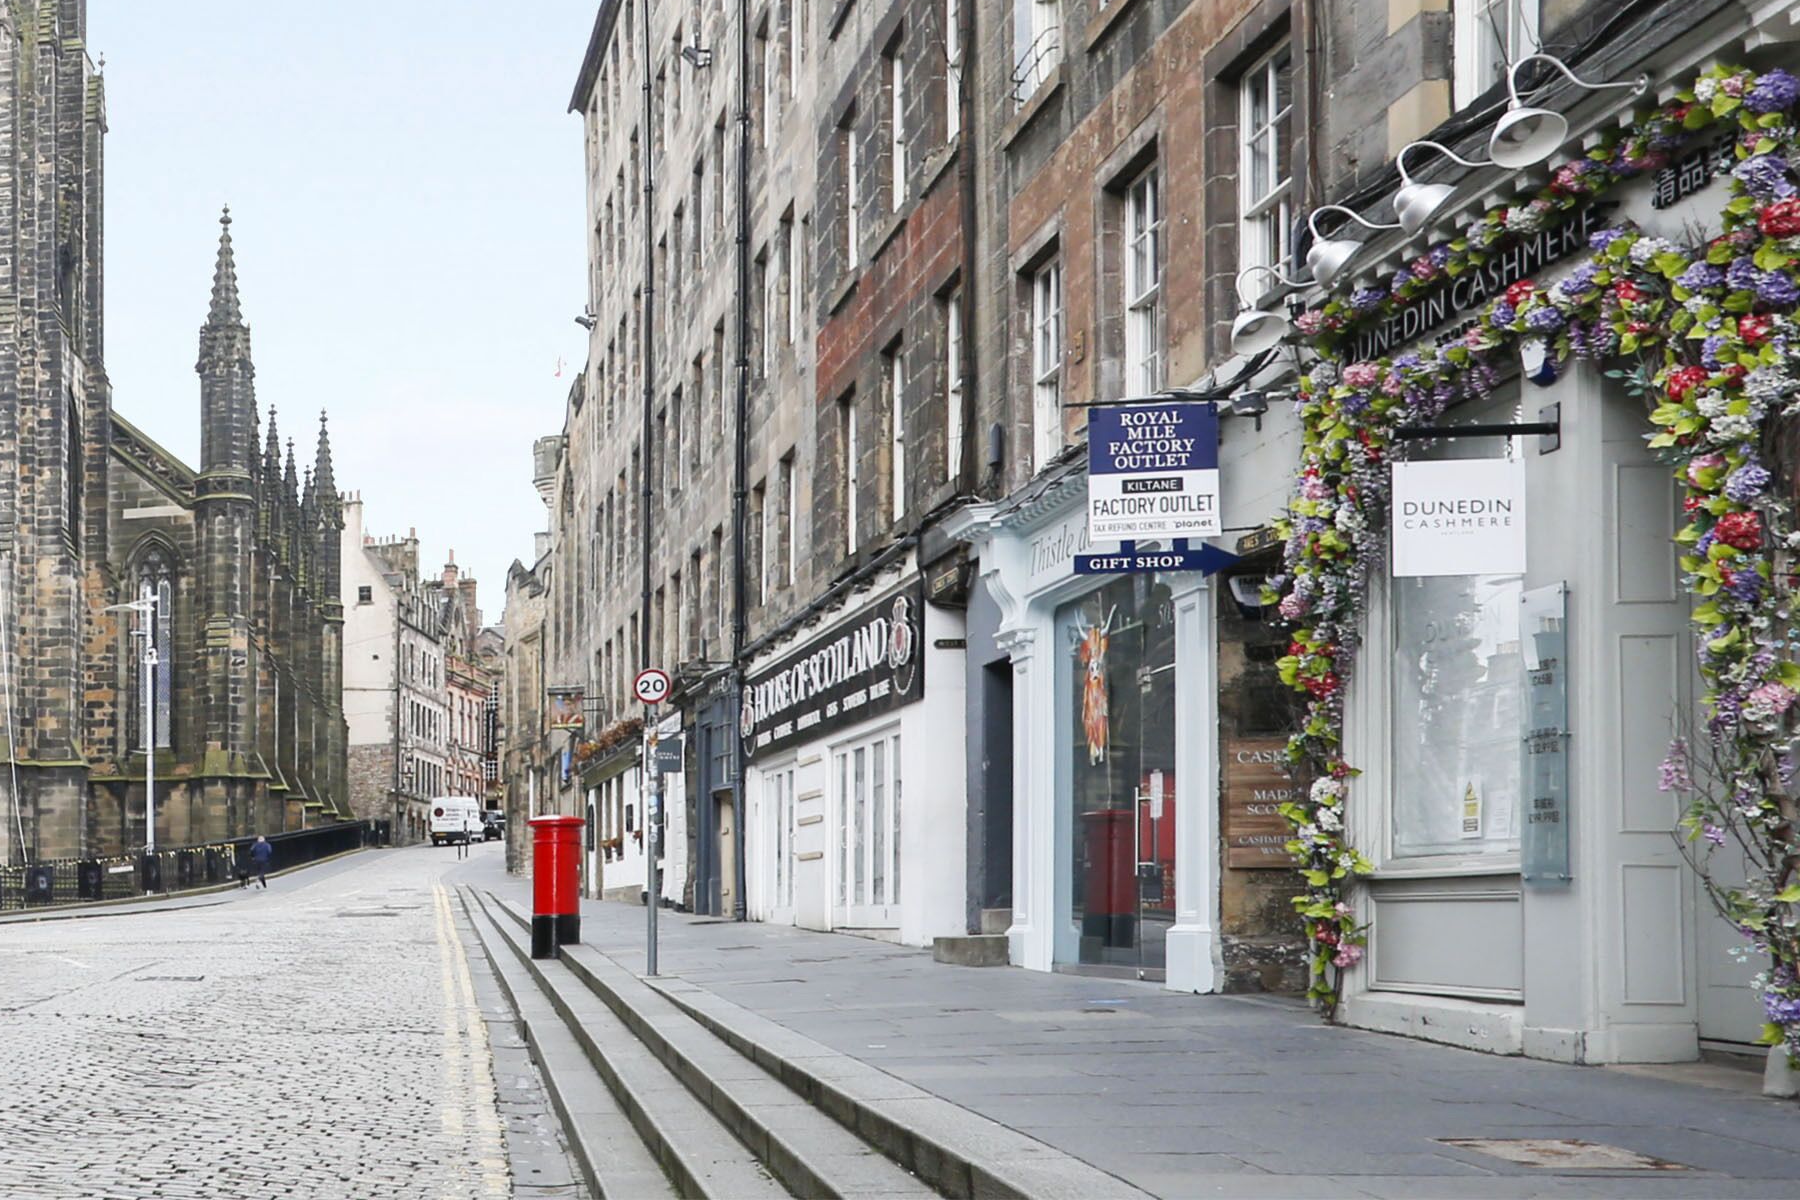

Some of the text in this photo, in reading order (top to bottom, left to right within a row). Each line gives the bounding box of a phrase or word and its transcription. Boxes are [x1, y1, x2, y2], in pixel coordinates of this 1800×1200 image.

[1119, 410, 1183, 427] ROYAL
[1127, 425, 1176, 440] MILE
[1108, 438, 1196, 456] FACTORY
[1114, 452, 1190, 469] OUTLET
[1127, 479, 1178, 492] KILTANE
[1093, 494, 1214, 517] FACTORY OUTLET
[1403, 499, 1512, 516] DUNEDIN
[1093, 524, 1106, 533] TAX
[1108, 522, 1137, 532] REFUND
[1139, 521, 1167, 531] CENTRE
[1403, 516, 1512, 530] CASHMERE
[1031, 524, 1074, 577] Thistle
[1088, 555, 1185, 570] GIFT SHOP
[754, 669, 792, 723] HOUSE
[790, 658, 810, 705] OF
[808, 617, 888, 698] SCOTLAND
[639, 679, 665, 694] 20
